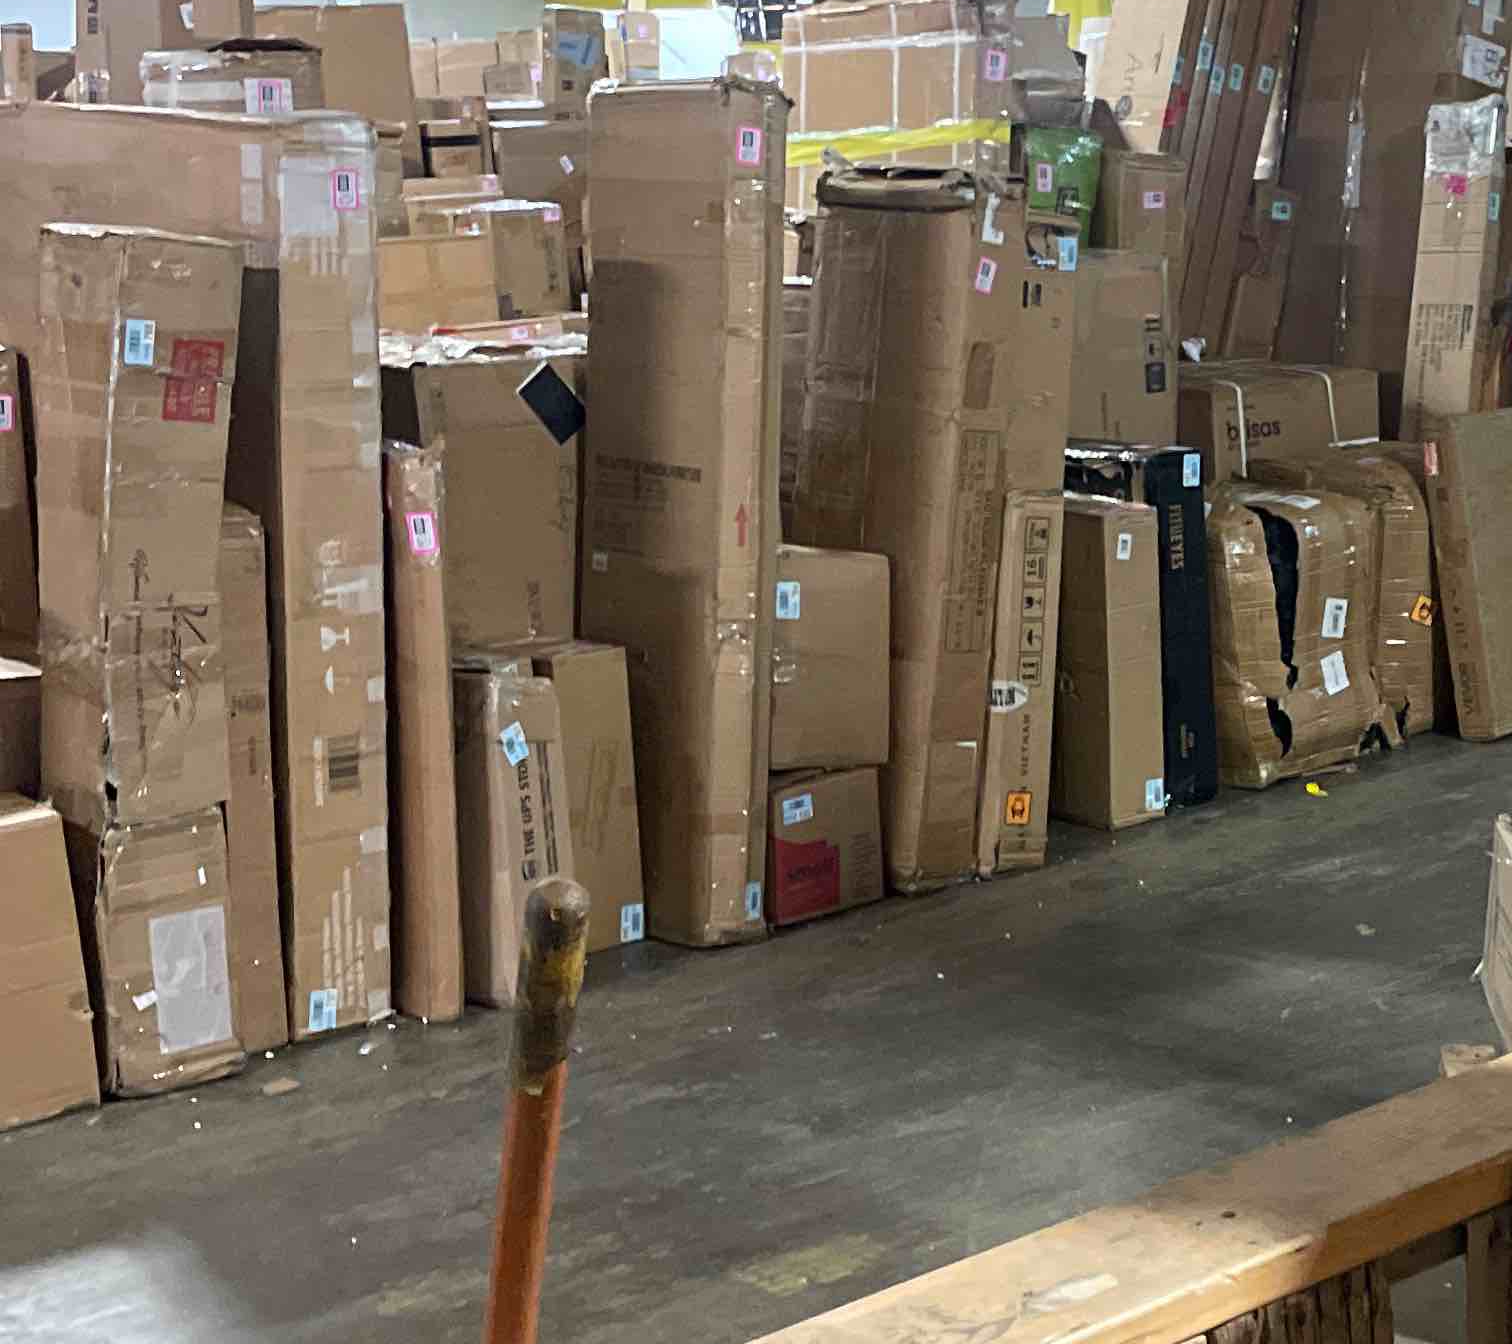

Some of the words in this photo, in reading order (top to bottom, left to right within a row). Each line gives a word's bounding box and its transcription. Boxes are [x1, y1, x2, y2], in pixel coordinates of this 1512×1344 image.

[1020, 713, 1031, 777] VIETNAM
[518, 757, 529, 791] STO
[521, 795, 532, 824] UPS
[523, 828, 535, 855] THE
